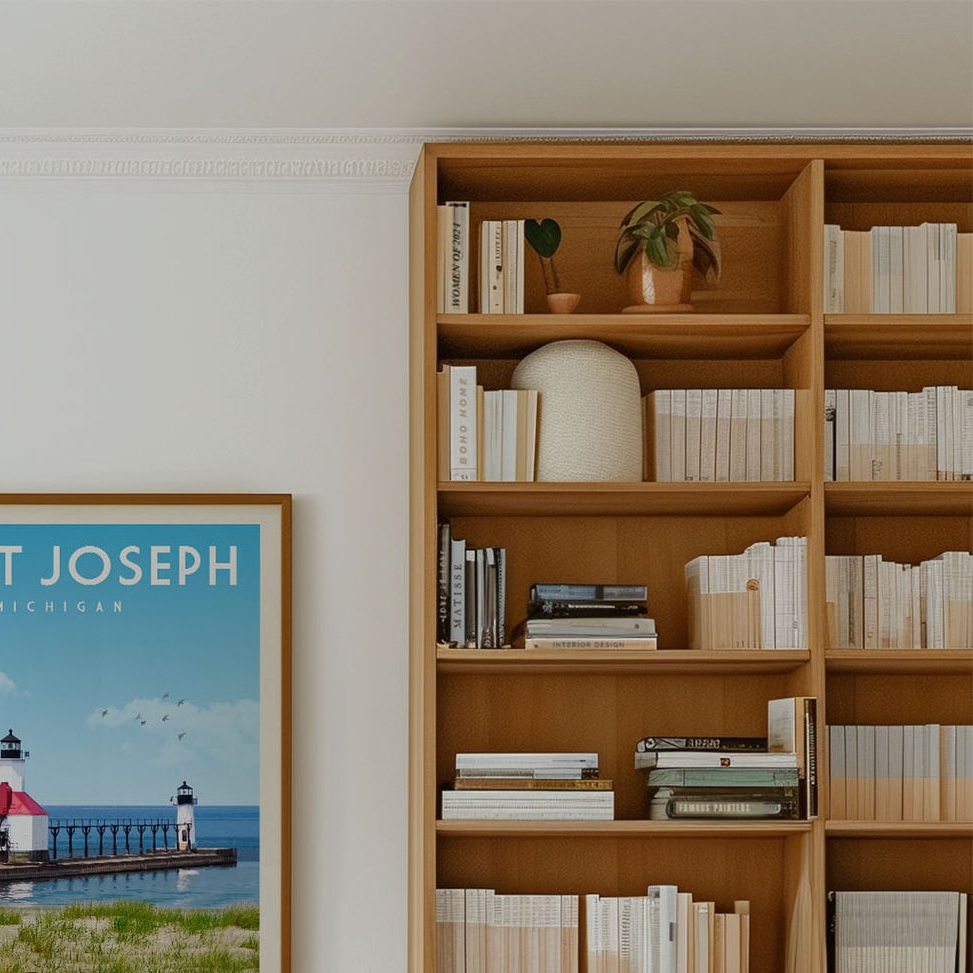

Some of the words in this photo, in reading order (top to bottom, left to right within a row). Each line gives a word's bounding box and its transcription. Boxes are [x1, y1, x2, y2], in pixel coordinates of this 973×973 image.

[452, 246, 461, 262] OF
[451, 264, 461, 307] WOMEN
[459, 377, 468, 418] HOME
[459, 425, 468, 465] BOHO
[39, 545, 238, 586] JOSEPH
[453, 562, 462, 629] MATISSE
[678, 803, 710, 812] FAMOUS
[713, 803, 750, 812] PAINTERS
